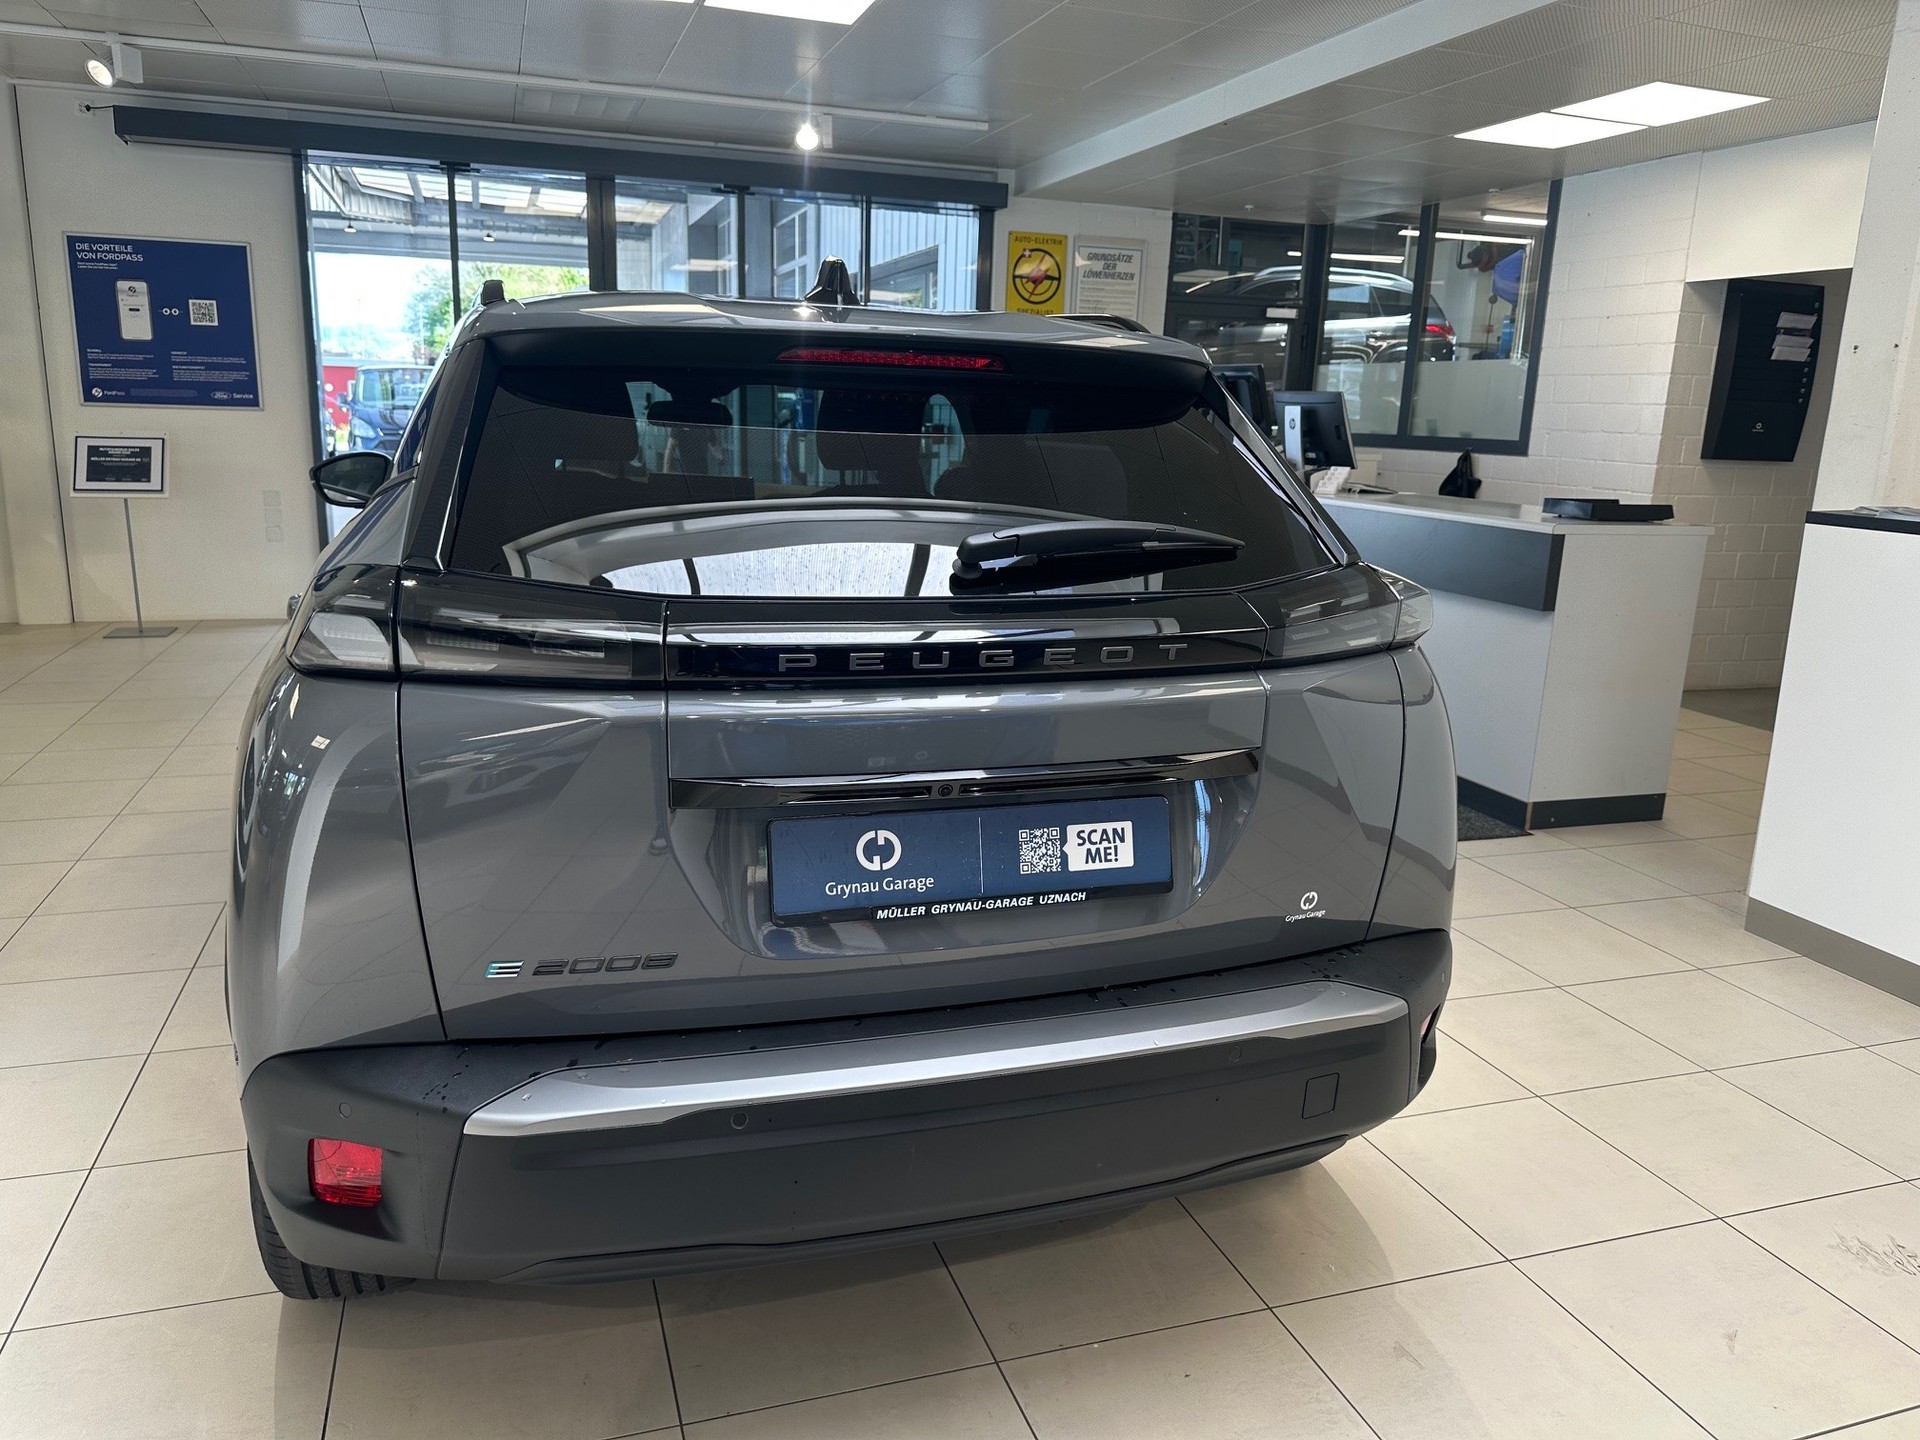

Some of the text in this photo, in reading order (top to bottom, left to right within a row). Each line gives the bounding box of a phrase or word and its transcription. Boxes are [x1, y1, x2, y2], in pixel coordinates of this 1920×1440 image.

[91, 244, 133, 252] VORTEILE
[1014, 236, 1063, 246] AUTO-ELEKTRIK
[76, 252, 144, 262] VON FORDPASS
[1087, 252, 1134, 263] GRUNDSÄTZE
[1102, 263, 1117, 271] DER
[1082, 270, 1136, 281] LÖWENHERZEN
[778, 642, 1188, 673] PEUGEOT
[1076, 827, 1126, 848] SCAN
[1083, 846, 1120, 865] ME!
[824, 875, 935, 899] Grynau Garage
[876, 892, 1087, 920] MÜLLER GRYNAU-GARAGE UZNACH
[532, 951, 679, 977] 2008
